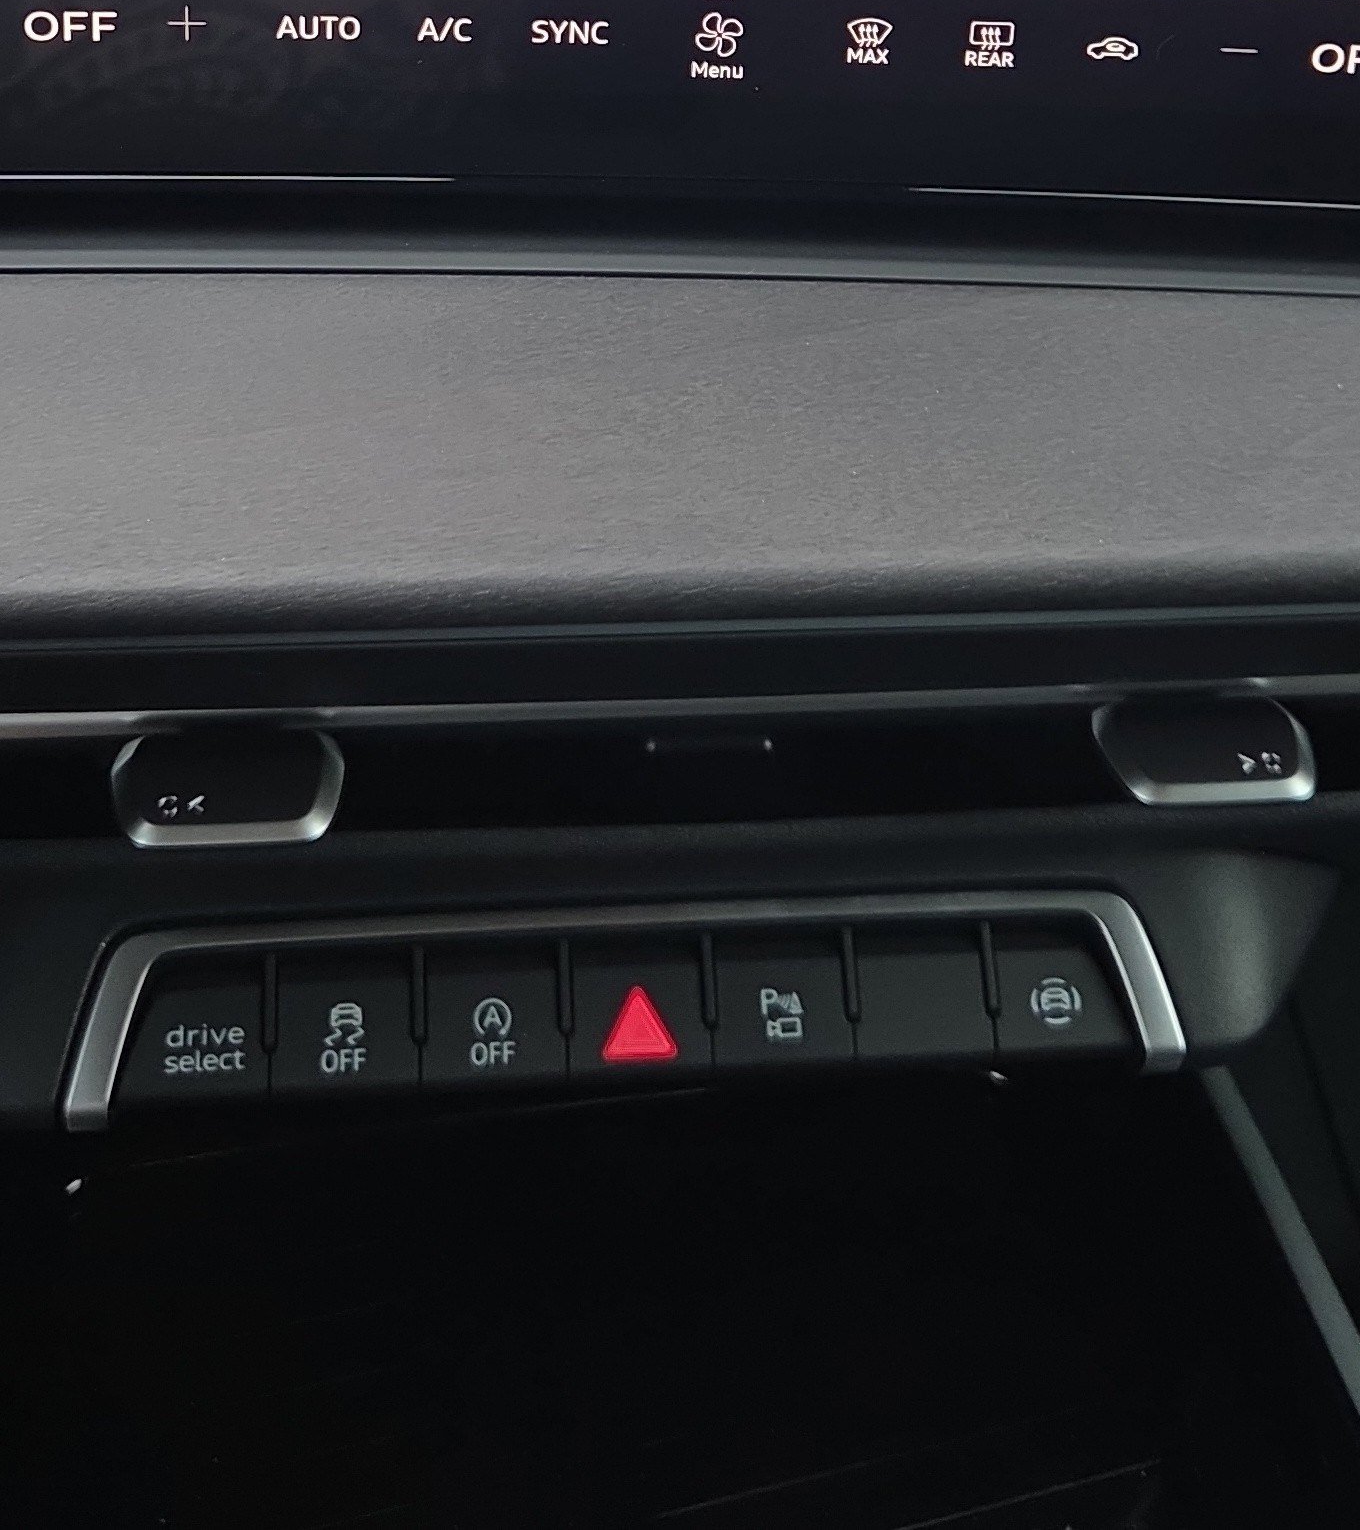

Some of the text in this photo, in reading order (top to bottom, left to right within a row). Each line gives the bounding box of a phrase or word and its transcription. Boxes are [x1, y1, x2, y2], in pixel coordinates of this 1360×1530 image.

[23, 10, 119, 43] OFF
[276, 14, 362, 41] AUTO
[417, 16, 474, 43] A/C
[531, 19, 611, 46] SYNC
[846, 47, 890, 66] MAX
[964, 48, 1016, 69] REAR
[690, 60, 745, 81] Menu
[165, 1024, 246, 1049] drive
[163, 1047, 247, 1074] select
[320, 1046, 367, 1074] OFF
[469, 1040, 517, 1067] OFF
